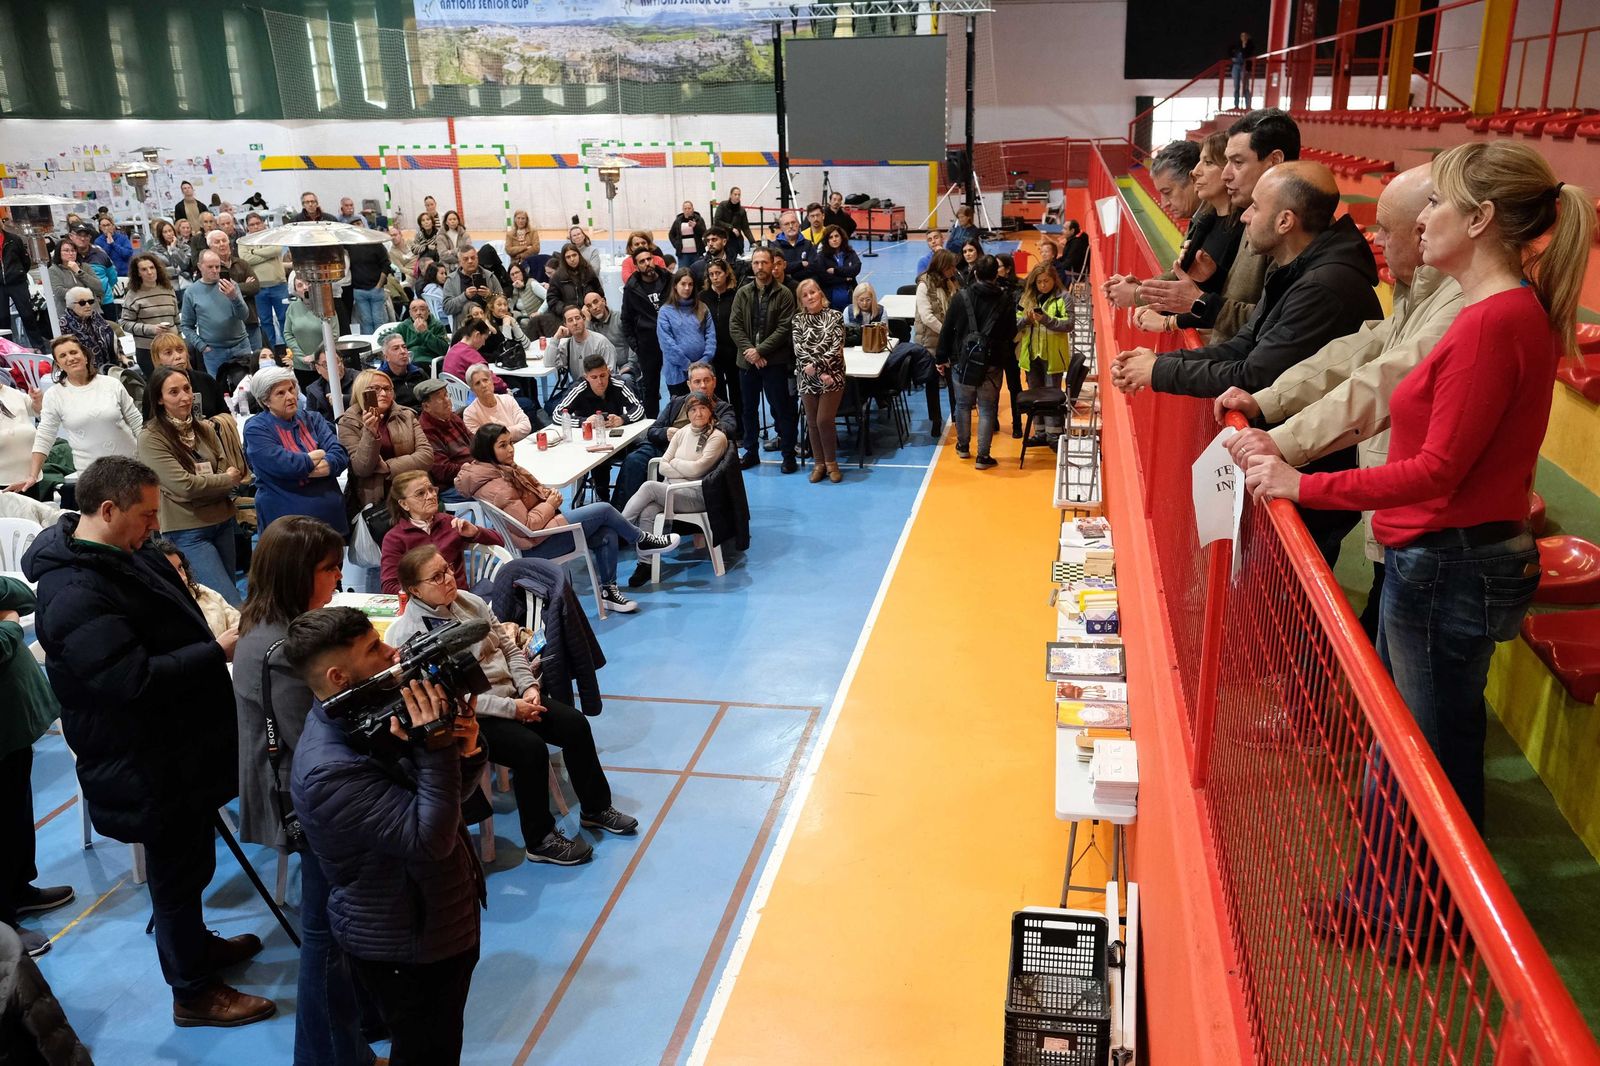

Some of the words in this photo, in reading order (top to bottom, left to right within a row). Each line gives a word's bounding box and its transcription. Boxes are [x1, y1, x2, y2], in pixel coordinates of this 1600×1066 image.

[440, 0, 476, 9] NATIONS
[479, 0, 510, 9] SENIOR
[511, 0, 529, 9] CUP
[266, 717, 276, 745] SONY
